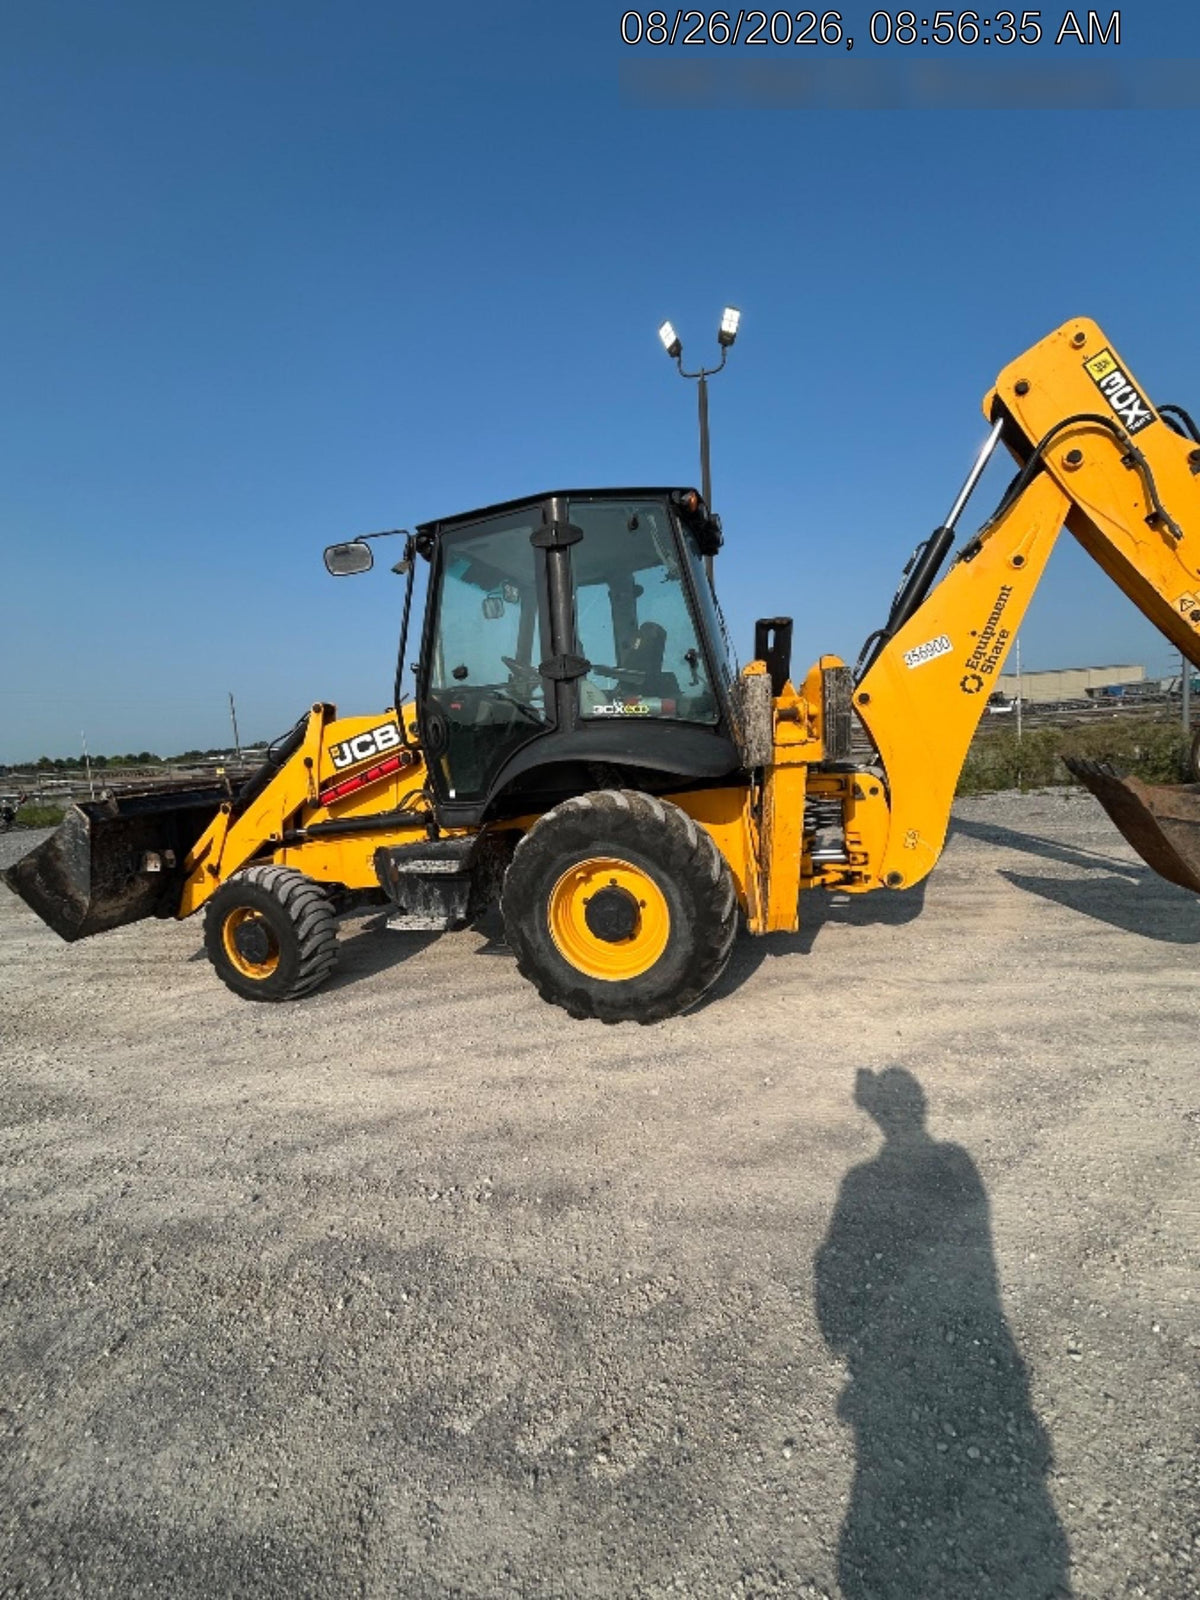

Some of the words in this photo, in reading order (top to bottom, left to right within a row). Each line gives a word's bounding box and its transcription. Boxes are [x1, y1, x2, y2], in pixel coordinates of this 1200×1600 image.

[903, 635, 950, 666] 356900
[965, 584, 1013, 671] Equipment
[980, 628, 1010, 675] Share
[333, 723, 401, 768] JCB
